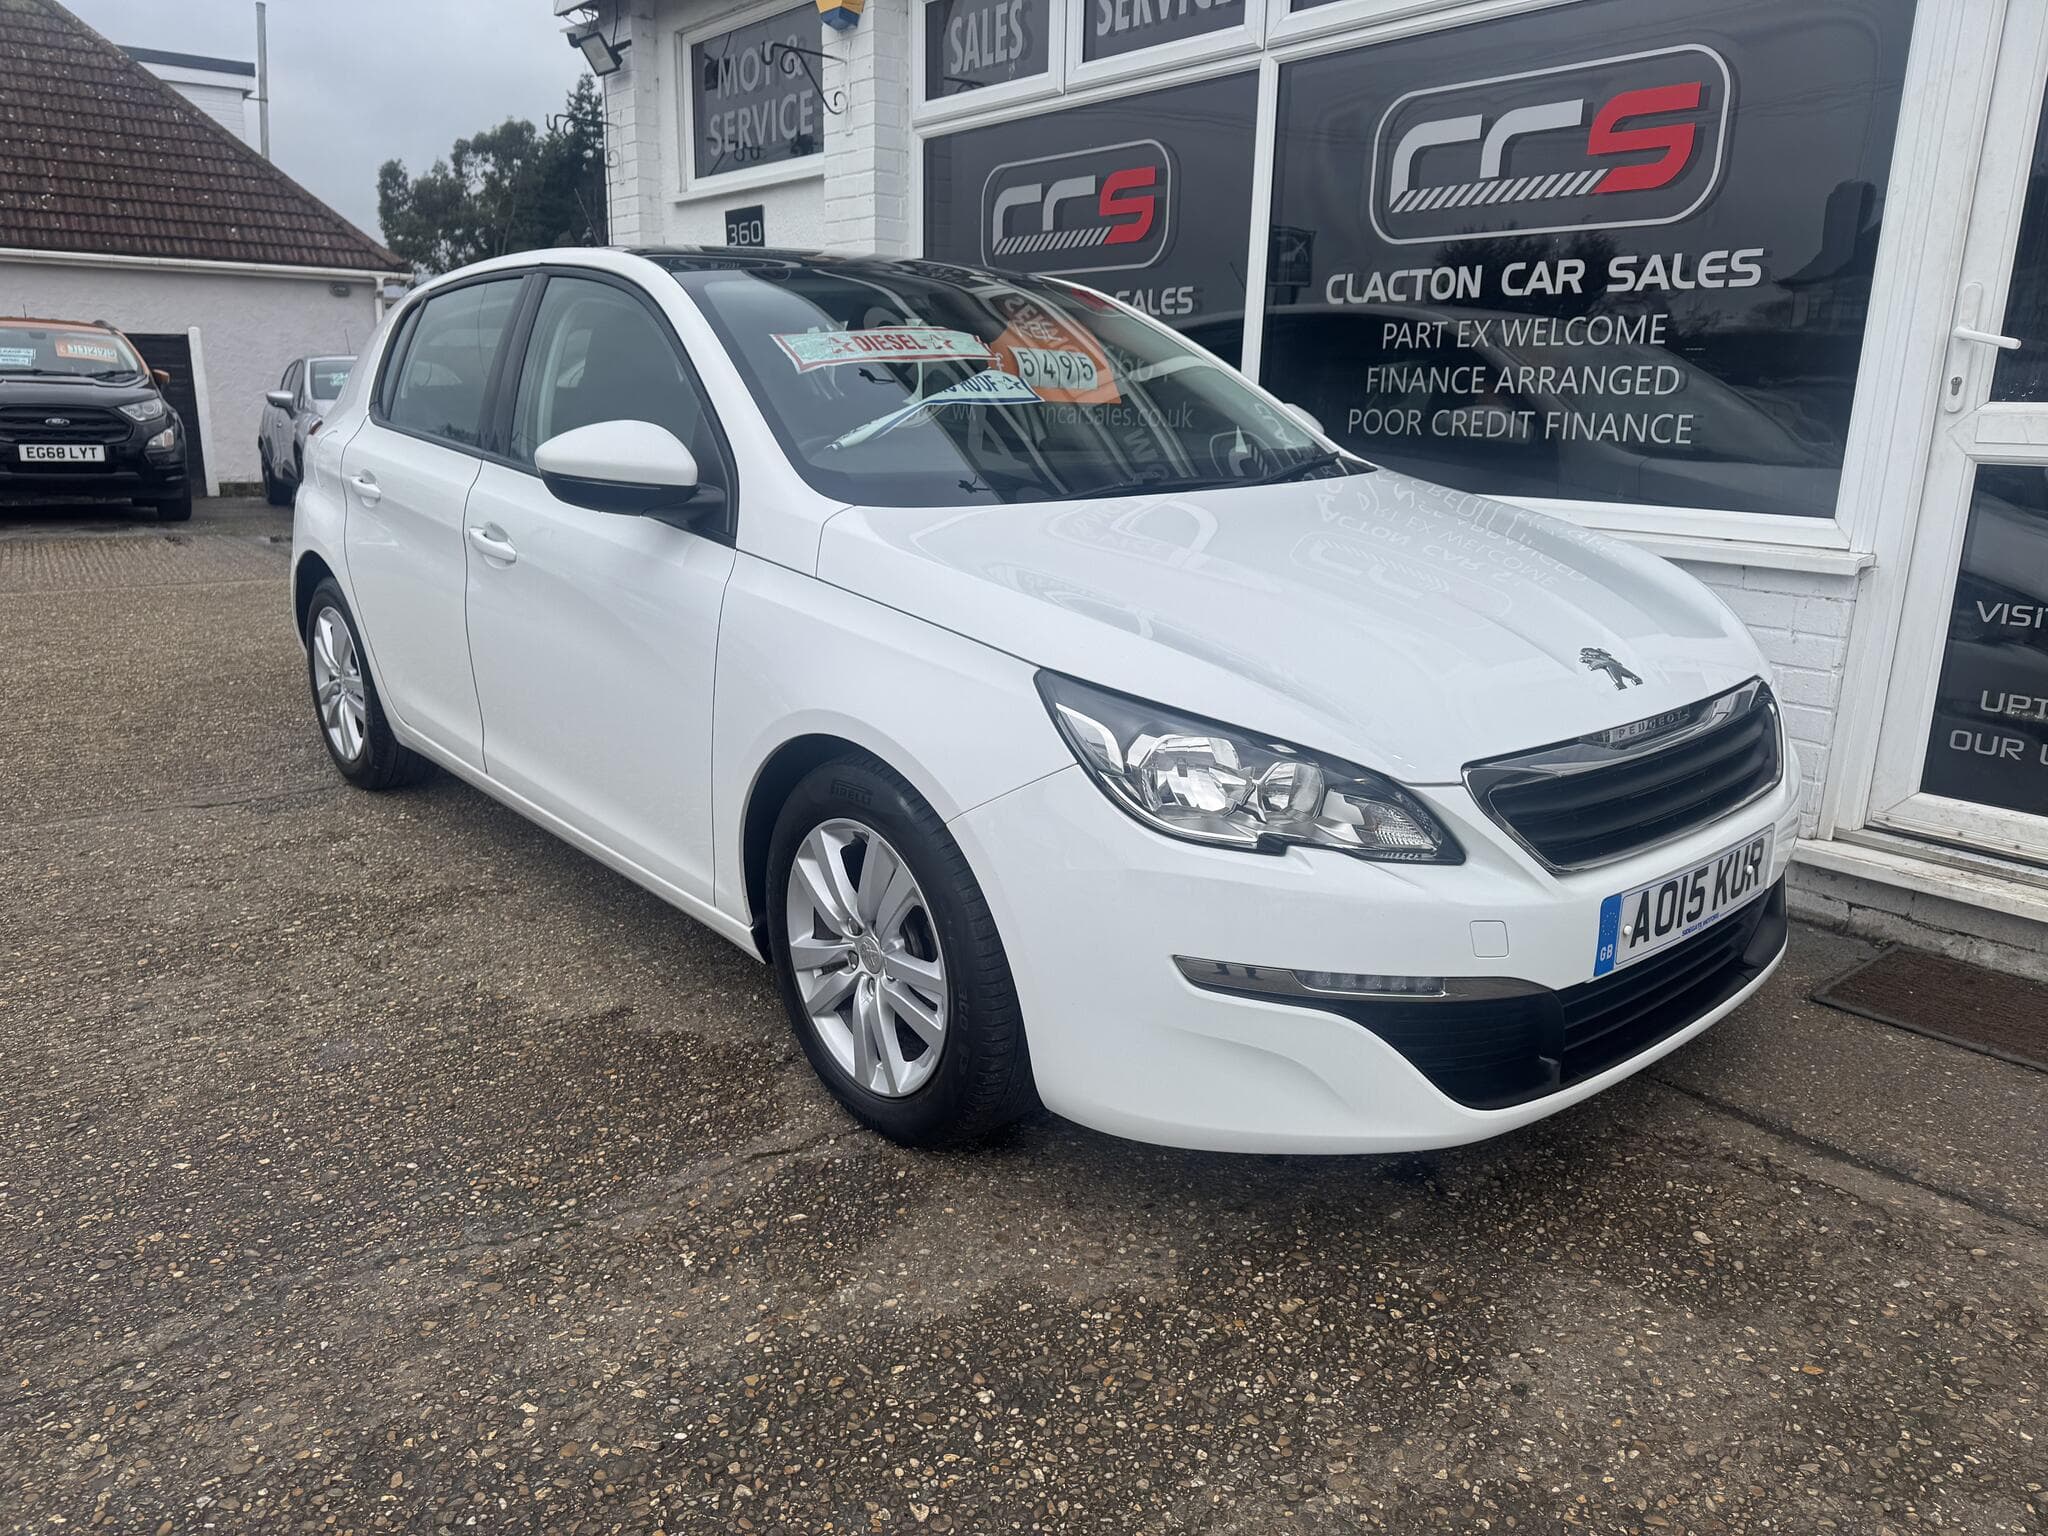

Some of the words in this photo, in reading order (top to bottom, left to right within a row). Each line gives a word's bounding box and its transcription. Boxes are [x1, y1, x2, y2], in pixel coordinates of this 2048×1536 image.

[950, 2, 1024, 75] SALES
[717, 40, 774, 100] MOT
[783, 34, 804, 80] &
[709, 90, 815, 157] SERVICE
[727, 219, 763, 246] 360
[1326, 265, 1483, 304] CLACTON
[1501, 259, 1586, 296] CAR
[1607, 247, 1765, 294] SALES
[852, 334, 928, 352] DIESEL
[1382, 321, 1448, 349] PART
[1456, 320, 1493, 348] EX
[1501, 314, 1668, 346] WELCOME
[1366, 367, 1485, 393] FINANCE
[1494, 365, 1681, 395] ARRANGED
[1347, 408, 1422, 435] POOR
[1431, 410, 1535, 438] CREDIT
[1545, 412, 1695, 444] FINANCE
[27, 447, 64, 459] EG68
[70, 447, 96, 459] LYT
[1976, 600, 2048, 629] VISI
[1950, 729, 2025, 761] OUR
[1629, 866, 1709, 949] AO15
[1712, 837, 1765, 911] KUR
[1600, 944, 1613, 961] GB
